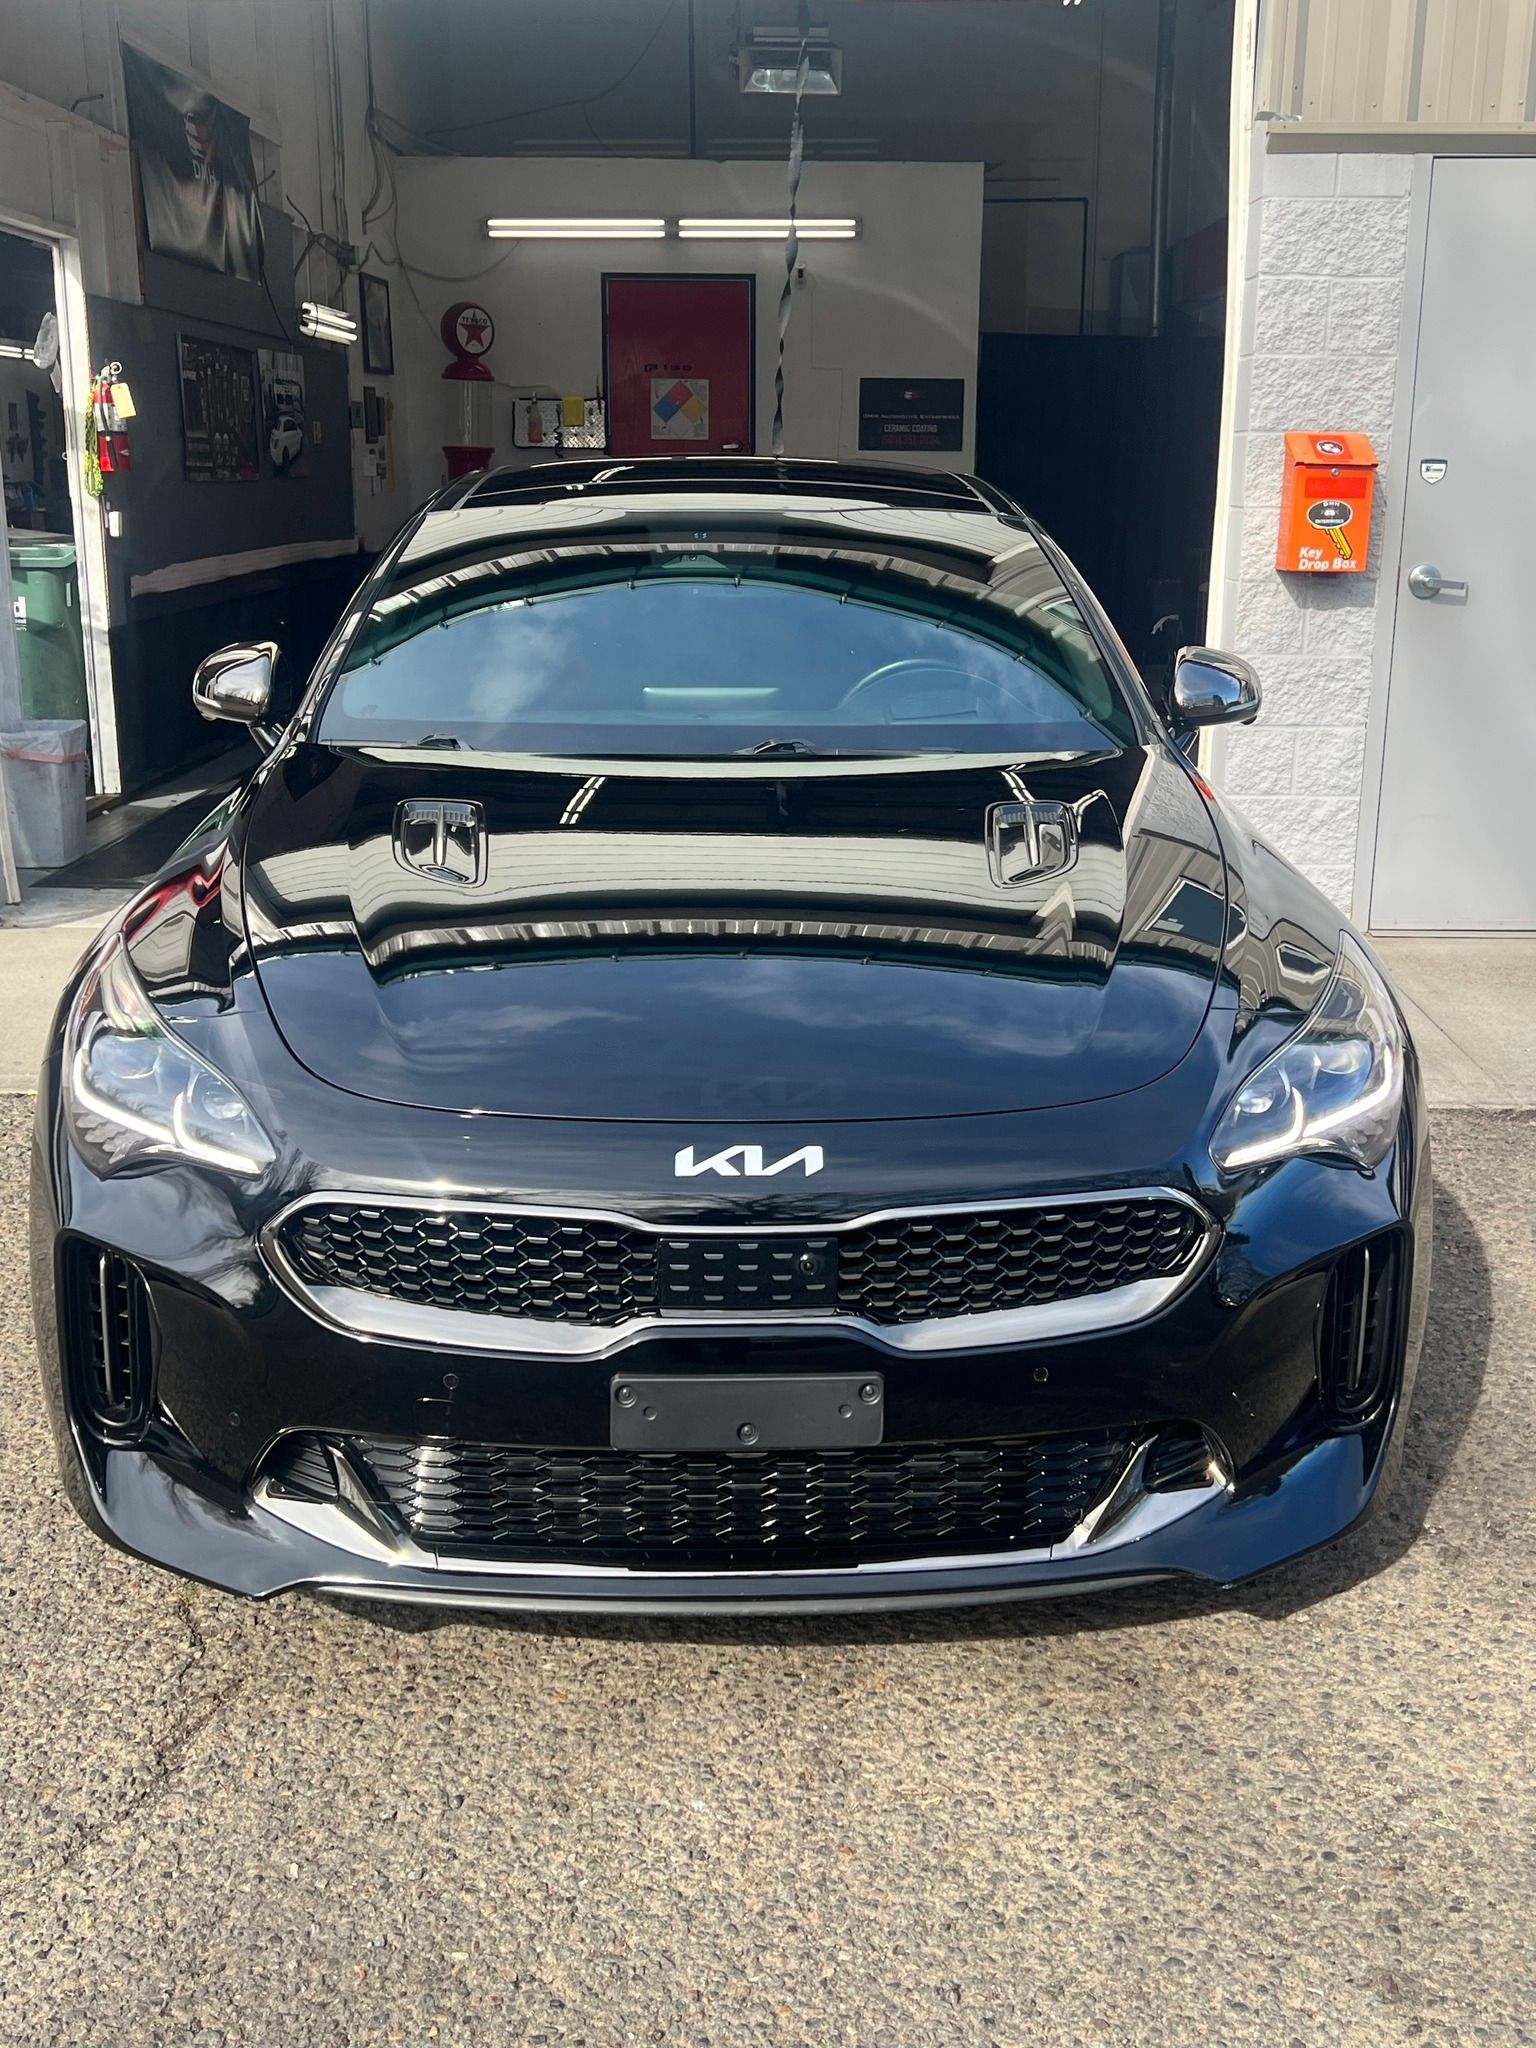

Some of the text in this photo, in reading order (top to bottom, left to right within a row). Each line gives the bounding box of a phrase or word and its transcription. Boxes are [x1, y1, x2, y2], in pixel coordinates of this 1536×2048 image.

[884, 424, 938, 432] CERAMIC COATING
[1299, 546, 1323, 560] Key
[1298, 557, 1357, 572] Drop Box
[674, 1144, 824, 1177] KIA
